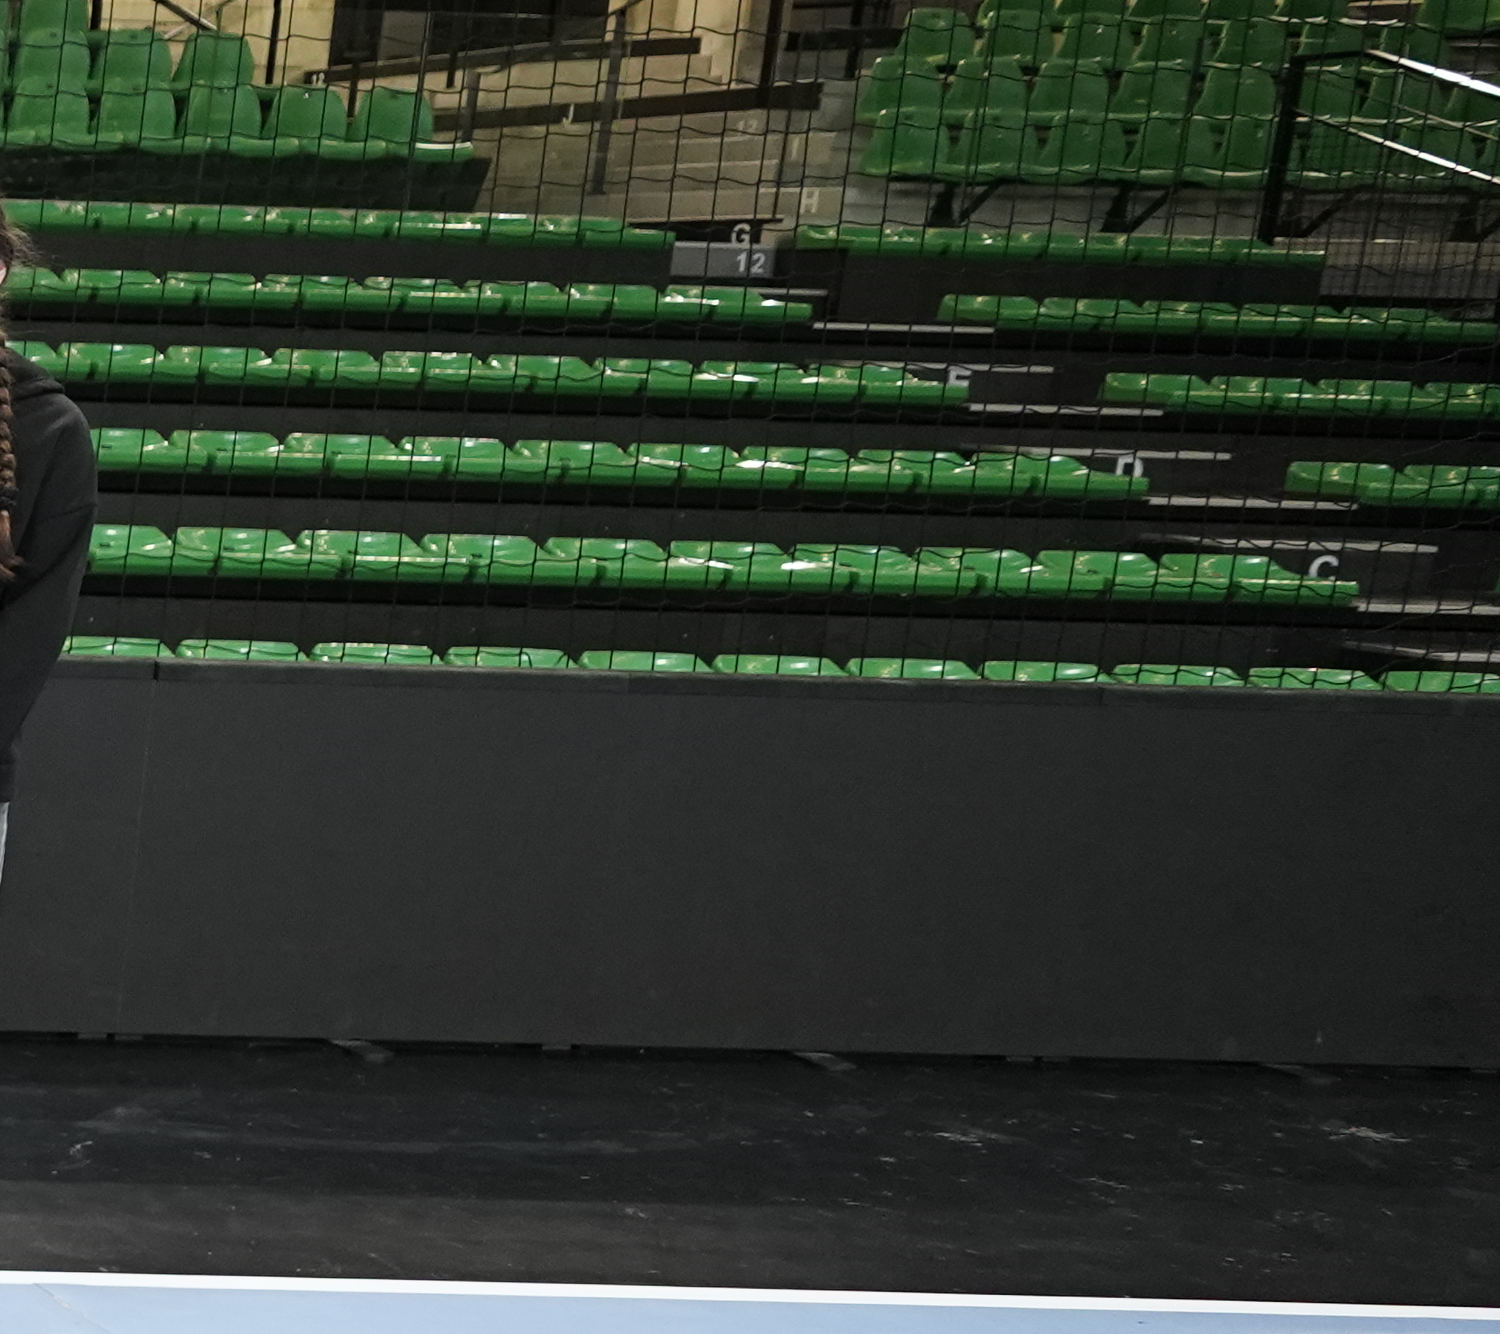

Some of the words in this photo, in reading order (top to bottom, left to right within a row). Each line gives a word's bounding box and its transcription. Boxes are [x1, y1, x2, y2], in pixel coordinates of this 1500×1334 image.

[800, 189, 820, 214] H
[731, 222, 751, 244] G
[736, 250, 766, 273] 12
